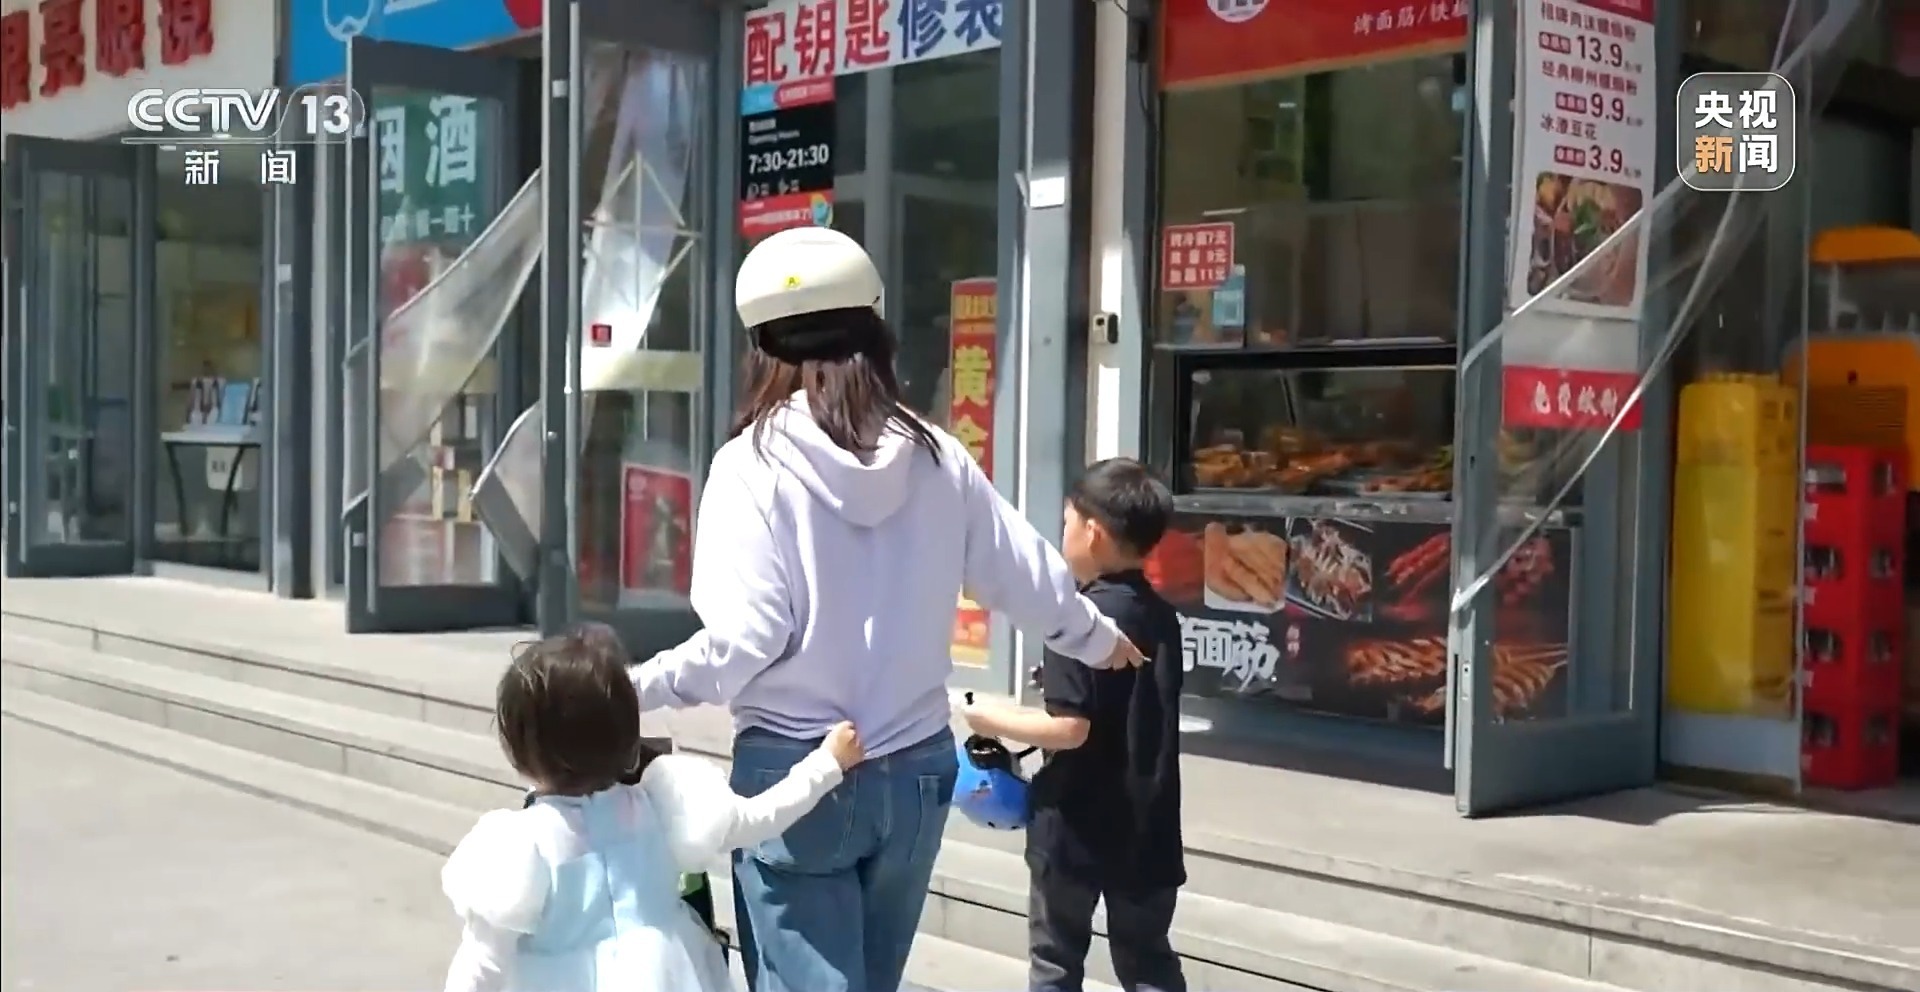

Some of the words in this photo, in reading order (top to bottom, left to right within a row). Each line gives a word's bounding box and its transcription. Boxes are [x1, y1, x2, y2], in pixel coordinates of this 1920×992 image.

[1577, 35, 1622, 67] 13.9
[1591, 93, 1624, 121] 9.9
[749, 143, 829, 174] 7:30-21:30
[1589, 144, 1623, 173] 3.9
